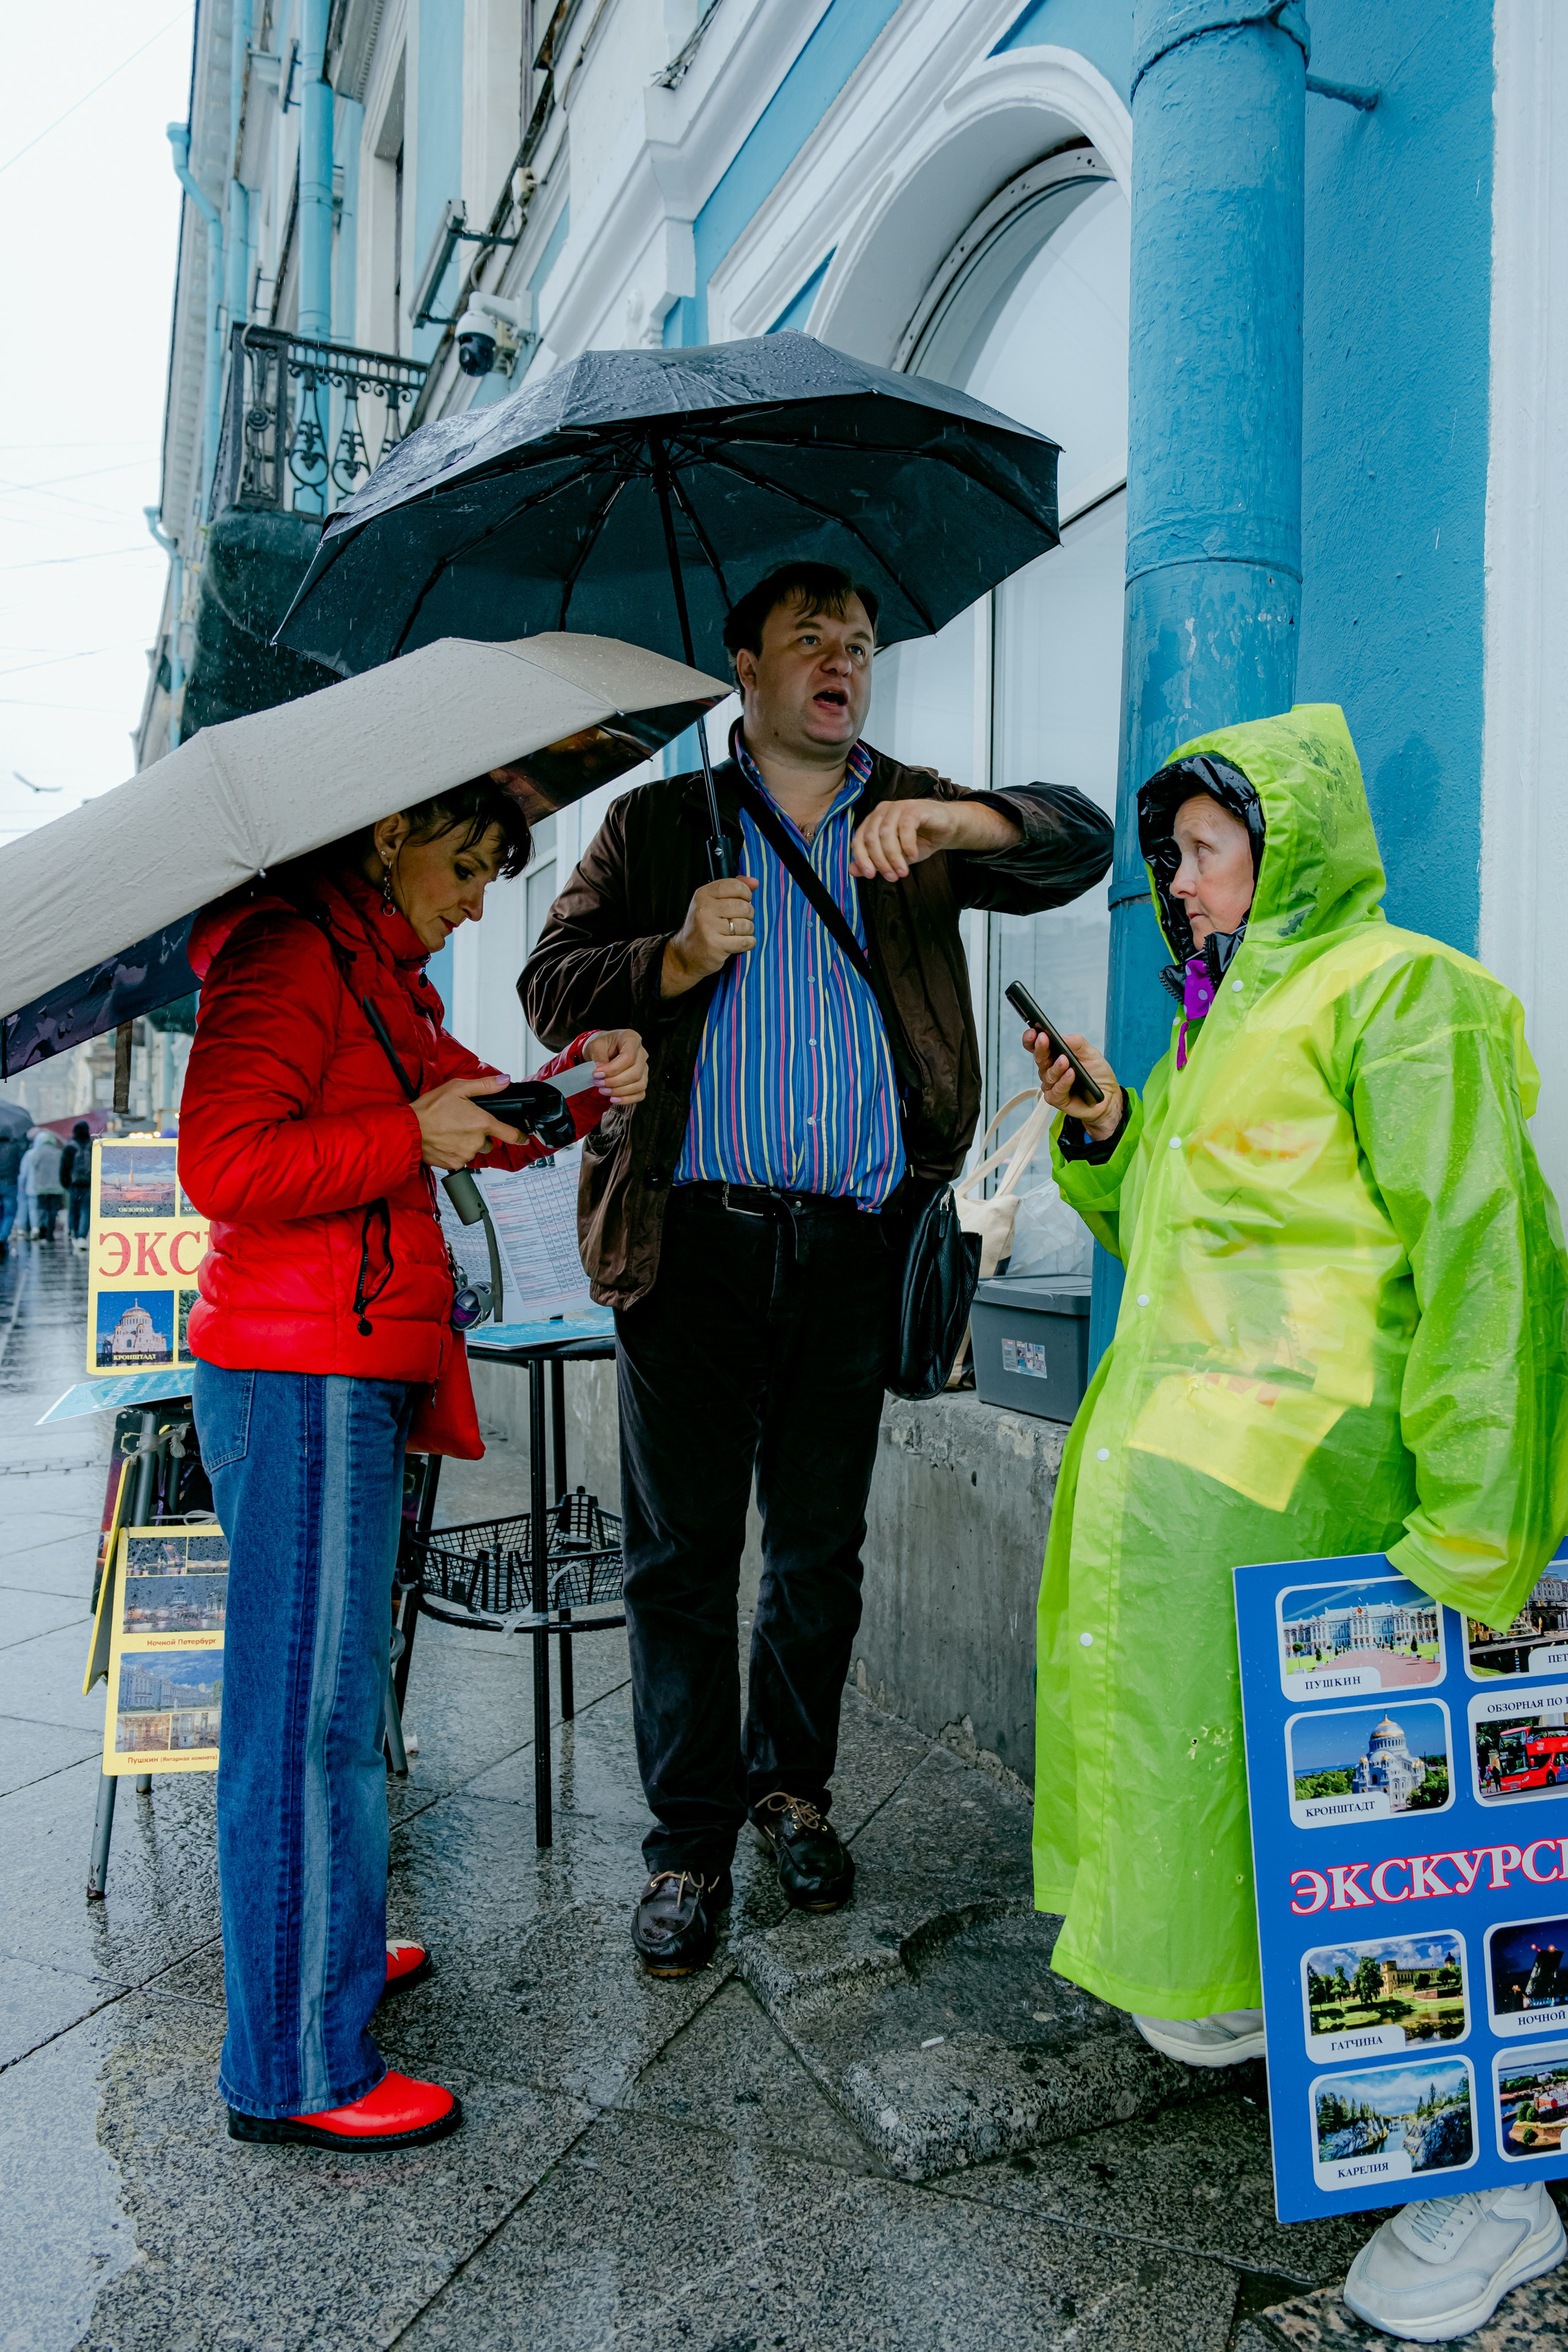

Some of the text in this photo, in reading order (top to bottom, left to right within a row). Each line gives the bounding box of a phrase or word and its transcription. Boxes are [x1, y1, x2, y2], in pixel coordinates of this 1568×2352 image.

[99, 1231, 215, 1276] ЭКС
[1305, 1676, 1361, 1690] ПУШКИН
[1487, 1699, 1544, 1713] ОБЗОРНАЯ
[1547, 1697, 1562, 1706] ПО
[1305, 1800, 1376, 1817] КРОНШТАДТ
[1518, 2010, 1566, 2026] НОЧНОЙ
[1330, 2035, 1384, 2051] ГАТЧИНА
[1337, 2162, 1389, 2179] КАРЕЛИЯ
